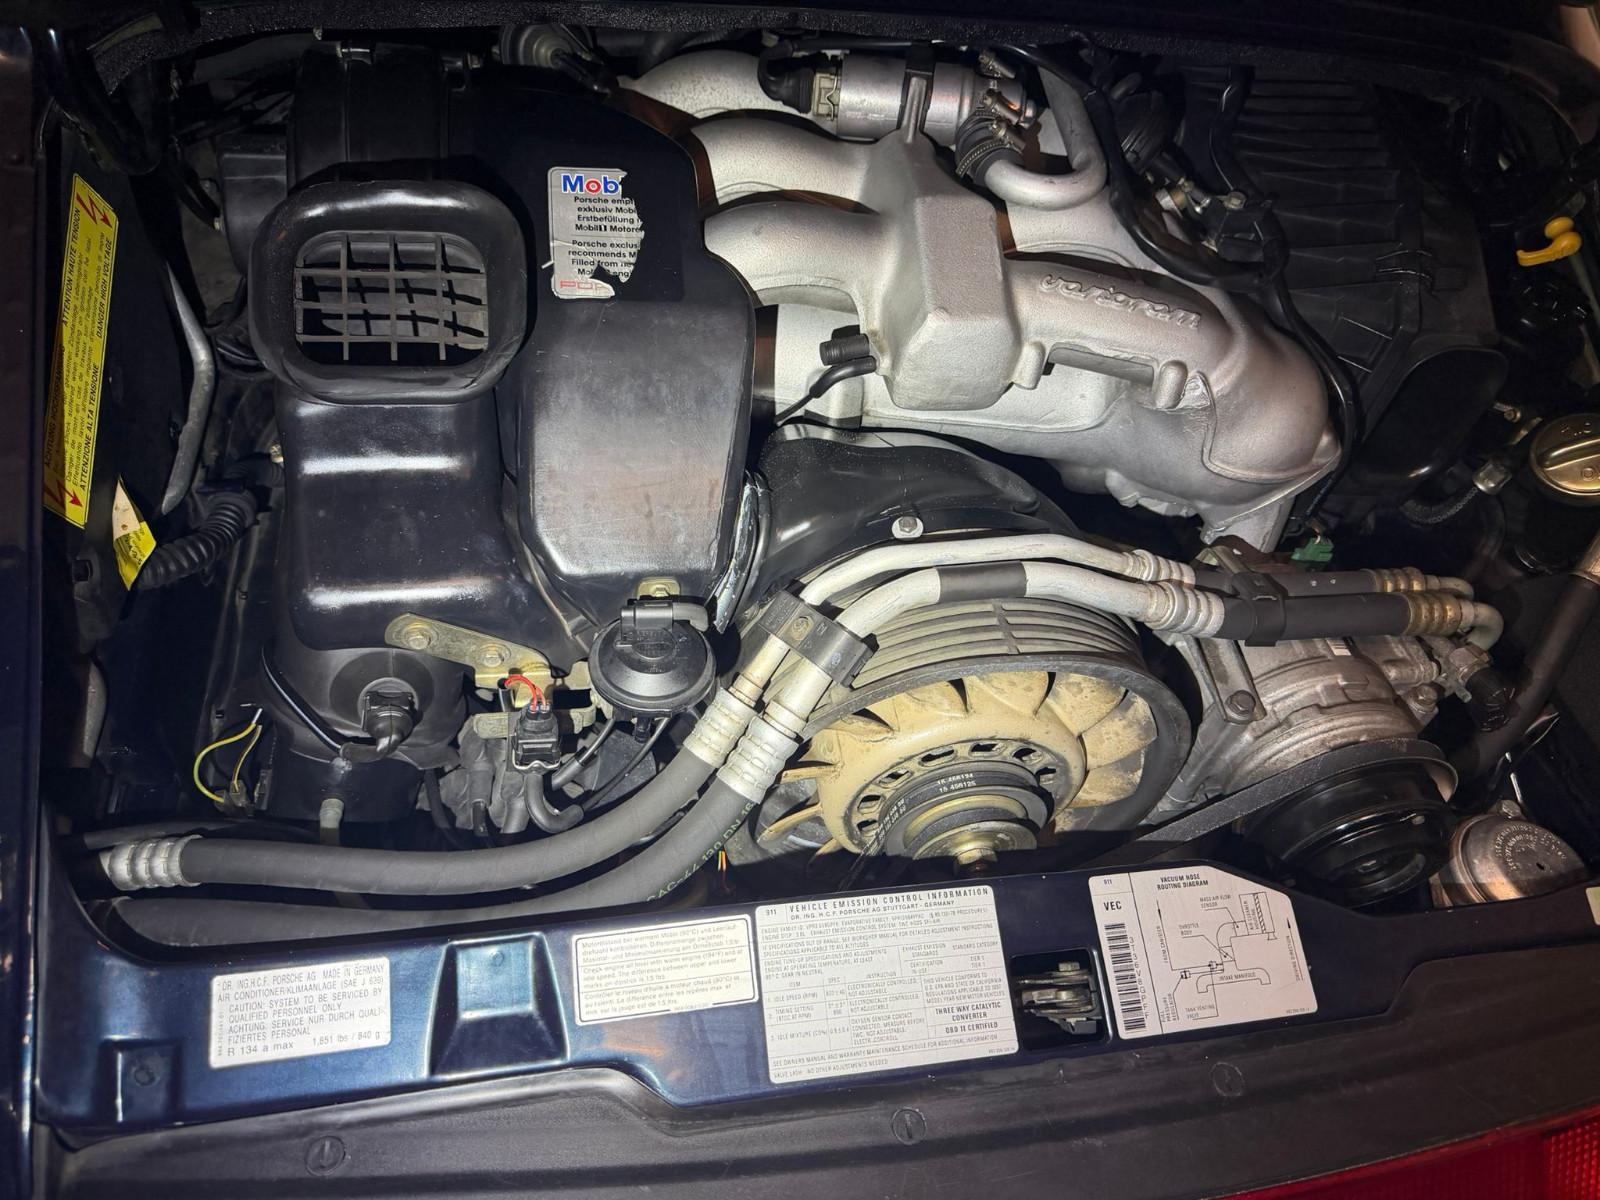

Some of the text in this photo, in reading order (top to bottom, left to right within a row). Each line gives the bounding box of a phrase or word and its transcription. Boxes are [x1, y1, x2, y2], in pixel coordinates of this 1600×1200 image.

[562, 175, 619, 194] Mob
[577, 215, 634, 224] Erstbefüllung
[62, 208, 81, 326] ATTENTION HAUTE TENSION
[96, 303, 106, 338] DANGER
[102, 237, 112, 277] VOLTAGE
[1040, 274, 1202, 329] varioram
[88, 363, 99, 406] TENSIONE
[86, 409, 95, 431] ALTA
[80, 435, 92, 491] ATTENZIONE
[1157, 880, 1209, 891] ROUTING DIAGRAM
[1160, 875, 1185, 883] VACUUM
[790, 902, 828, 913] VEHICLE
[833, 897, 878, 909] EMISSION
[883, 894, 923, 904] CONTROL
[927, 887, 988, 900] INFORMATION
[1103, 901, 1123, 911] VEC
[839, 907, 870, 916] PORSCHE
[883, 904, 918, 912] STUTTGART
[272, 973, 304, 985] PORSCHE
[306, 971, 316, 981] AG
[322, 968, 340, 979] MADE
[344, 967, 351, 977] IN
[354, 964, 385, 976] GERMANY
[217, 993, 230, 1003] AIR
[269, 997, 300, 1008] SYSTEM
[304, 995, 314, 1004] TO
[318, 993, 329, 1002] BE
[332, 989, 369, 1001] SERVICED
[372, 987, 383, 996] BY
[229, 1002, 343, 1024] QUALIFIED PERSONNEL ONLY
[935, 1006, 954, 1015] THREE
[971, 1002, 1001, 1010] CATALYTIC
[952, 1011, 987, 1021] CONVERTER
[271, 1017, 305, 1029] SERVICE
[309, 1015, 324, 1025] NUR
[328, 1011, 355, 1022] DURCH
[967, 1022, 998, 1031] CERTIFIED
[227, 1047, 235, 1057] R
[240, 1045, 258, 1055] 134
[273, 1042, 294, 1051] max
[337, 1034, 348, 1042] lbs
[374, 1031, 380, 1040] g
[228, 1027, 311, 1045] FIZIERTES PERSONAL
